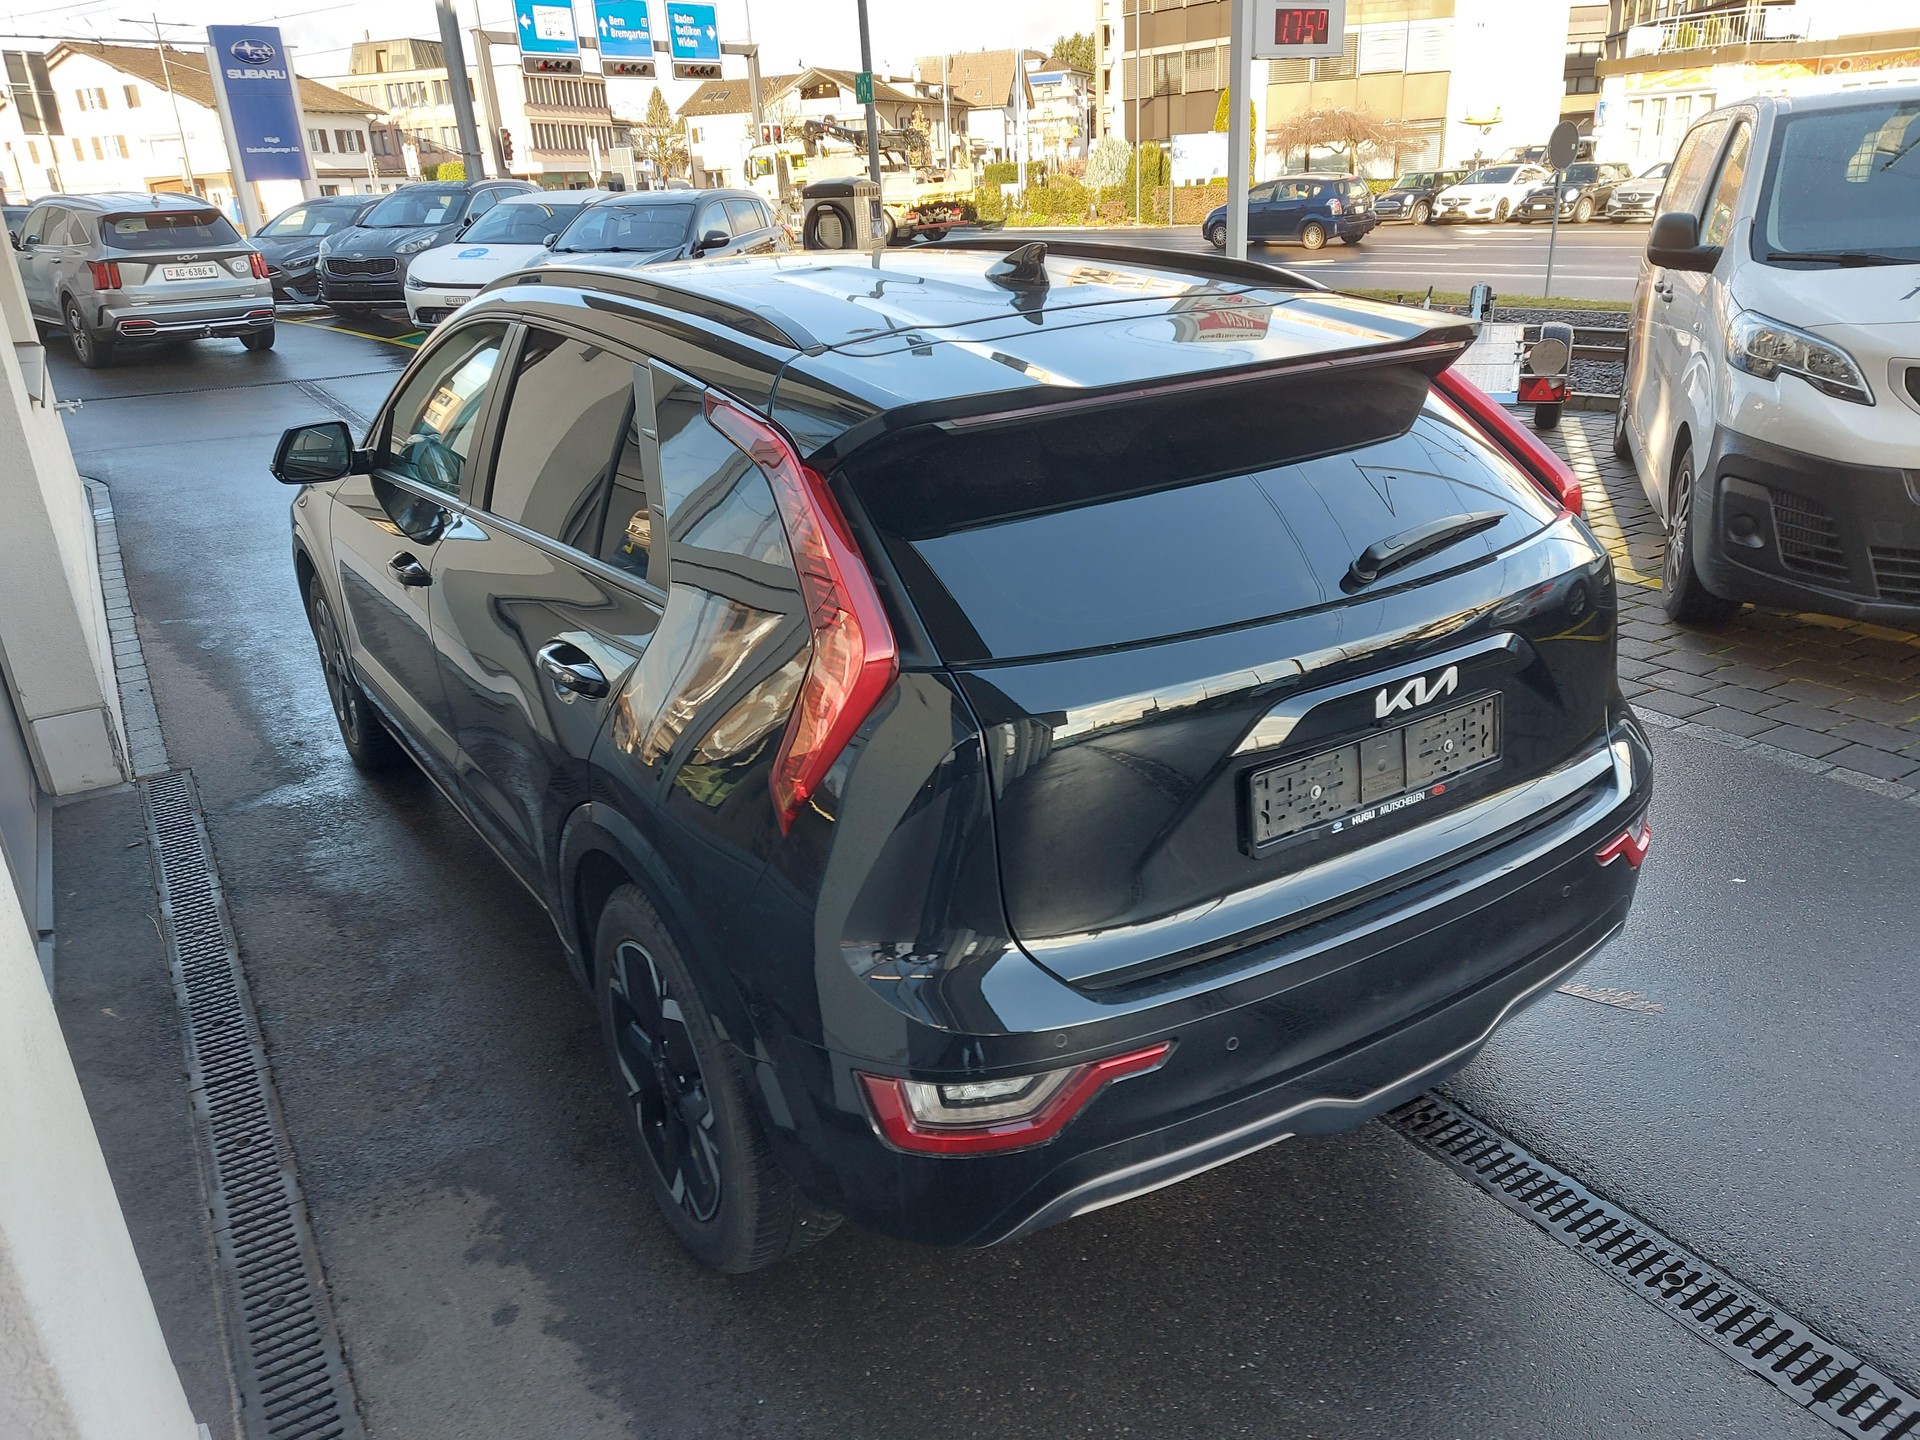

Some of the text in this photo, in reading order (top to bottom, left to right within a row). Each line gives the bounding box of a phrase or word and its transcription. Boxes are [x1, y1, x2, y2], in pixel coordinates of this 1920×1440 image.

[608, 14, 625, 26] Bern
[674, 13, 695, 25] Baden
[610, 28, 650, 41] Bremgarten
[675, 25, 702, 37] Bellikon
[677, 37, 699, 48] Widen
[226, 69, 287, 79] SUBARU
[235, 262, 246, 271] CH
[1375, 665, 1459, 719] KIA
[1380, 791, 1426, 815] MUTSCHELLEN
